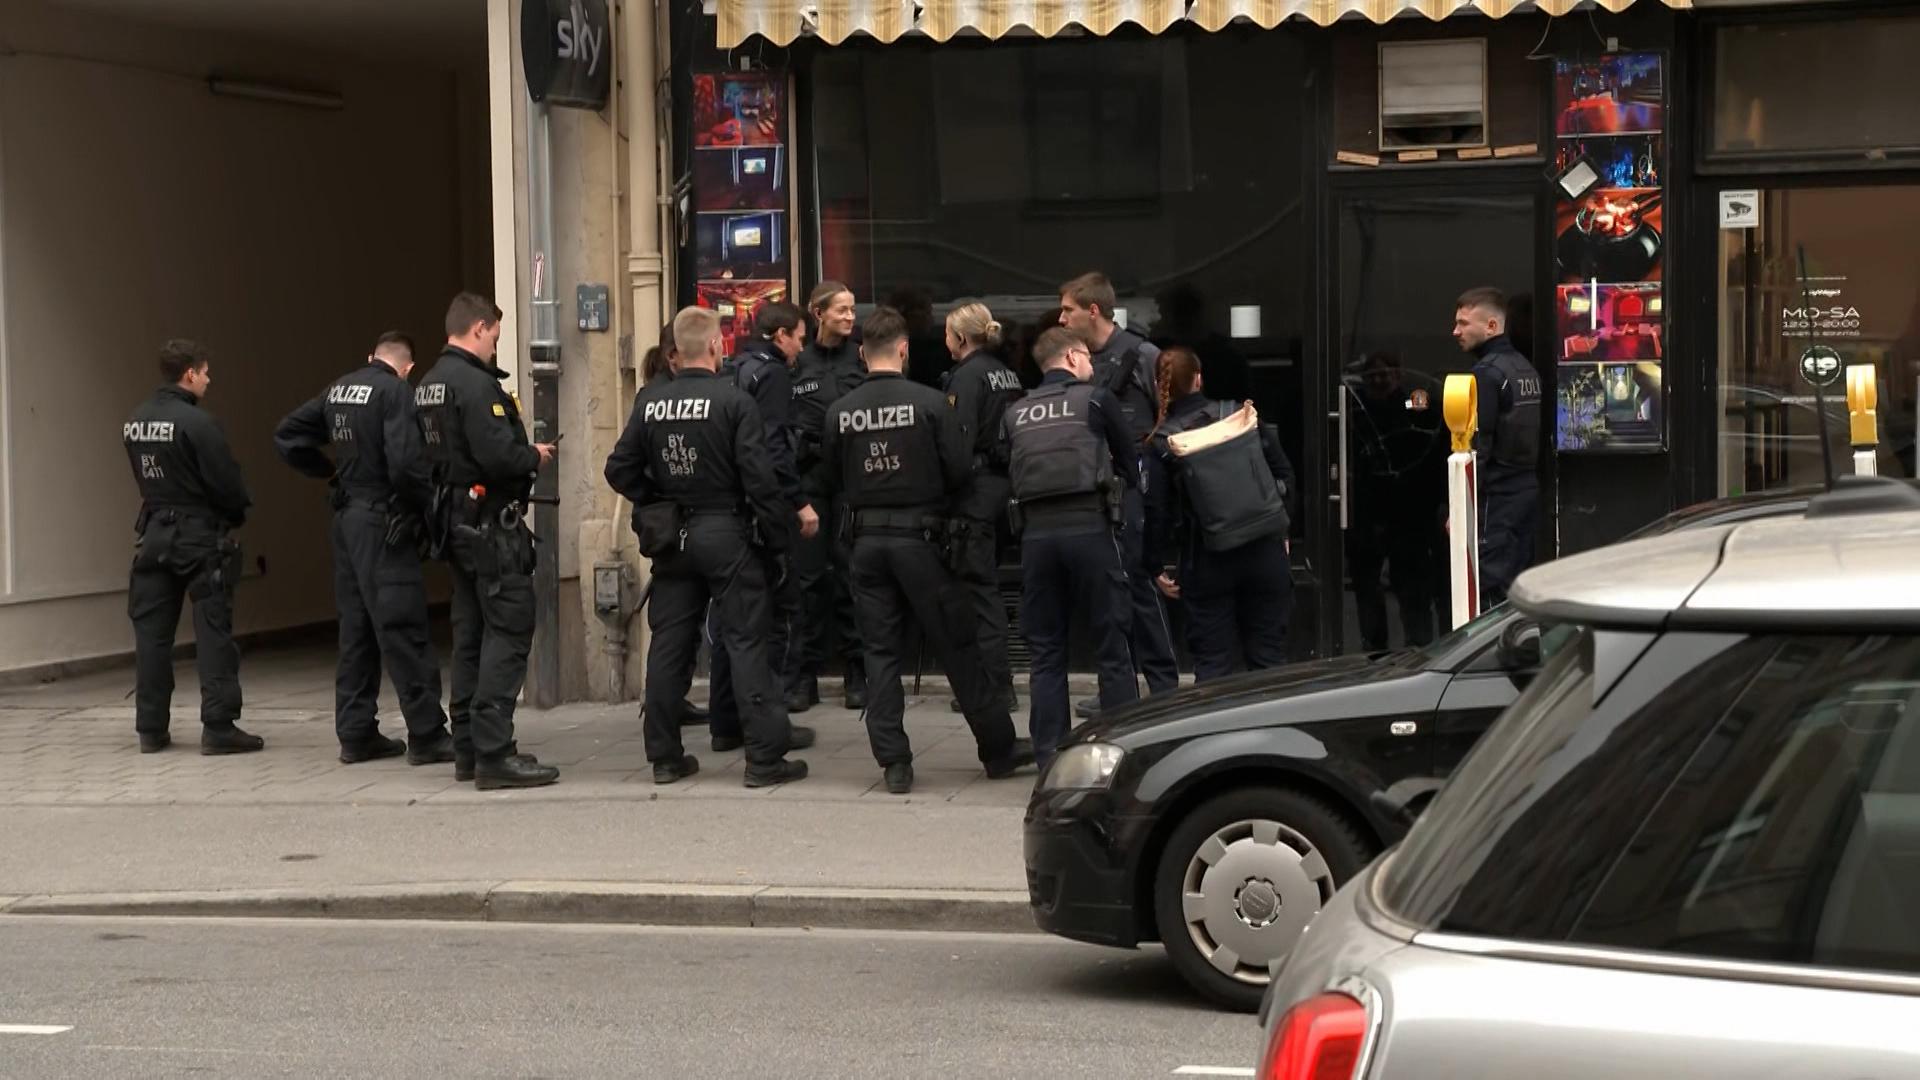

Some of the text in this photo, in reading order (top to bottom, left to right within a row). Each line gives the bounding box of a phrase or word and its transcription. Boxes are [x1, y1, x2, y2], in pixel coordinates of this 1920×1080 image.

[557, 4, 602, 76] sky
[1783, 306, 1860, 319] MO-SA
[644, 398, 711, 423] POLIZEI
[839, 403, 914, 434] POLIZEI
[1015, 401, 1076, 426] ZOLL
[123, 421, 175, 442] POLIZEI
[668, 433, 684, 448] BY
[870, 441, 888, 456] BY
[141, 455, 155, 466] BY
[864, 455, 900, 472] 6413
